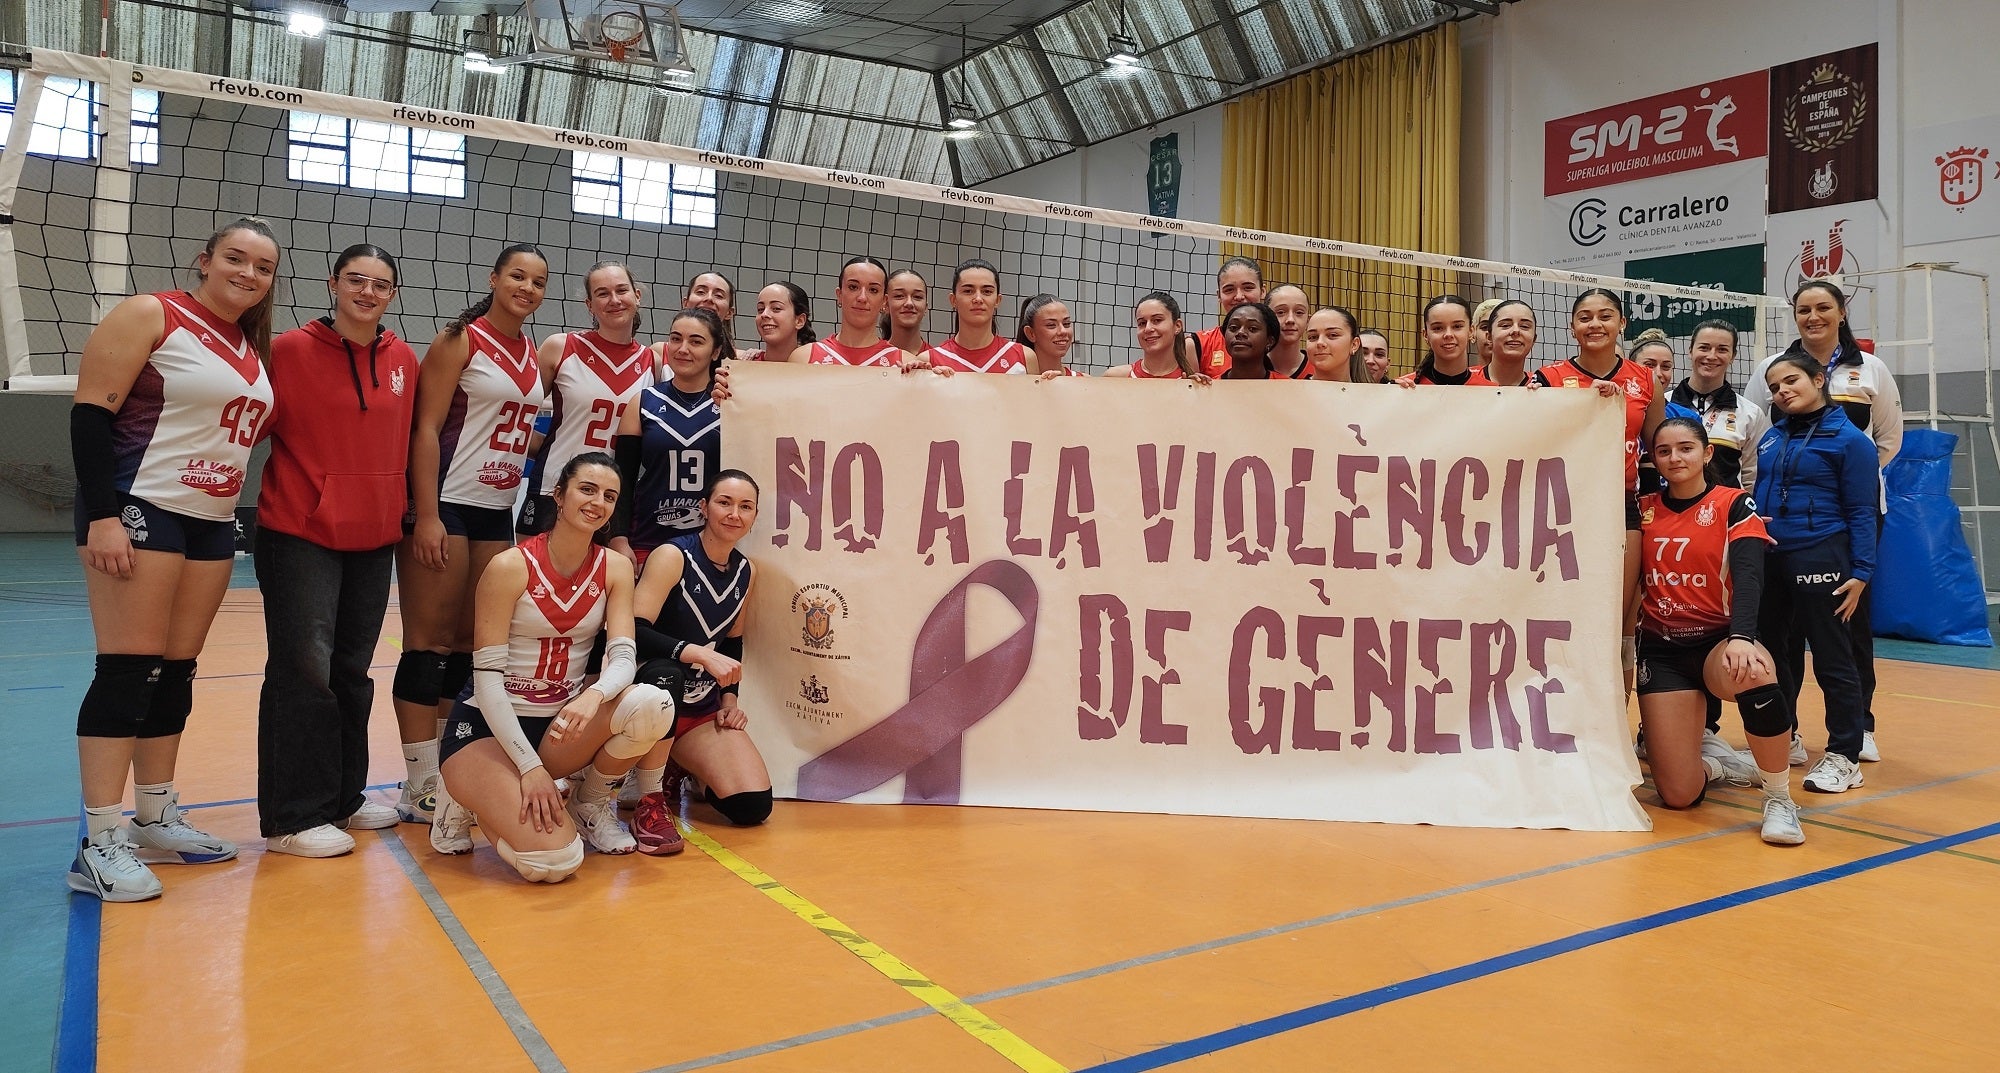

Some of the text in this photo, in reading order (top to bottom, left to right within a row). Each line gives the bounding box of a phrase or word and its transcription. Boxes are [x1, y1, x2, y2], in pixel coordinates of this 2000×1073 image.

[210, 79, 303, 104] rfevb.com
[1801, 87, 1848, 104] CAMPEONES
[1819, 99, 1830, 110] DE
[393, 106, 475, 129] rfevb.com
[1809, 107, 1839, 121] ESPAÑA
[555, 131, 628, 152] rfevb.com
[1568, 105, 1688, 164] SM-2
[698, 151, 764, 170] rfevb.com
[1566, 144, 1704, 182] SUPERLIGA VOLEIBOL MASCULINA
[827, 171, 885, 189] rfevb.com
[1154, 162, 1172, 187] 13
[941, 188, 994, 205] rfevb.com
[1045, 204, 1093, 219] rfevb.com
[1619, 196, 1728, 226] Carralero
[1139, 216, 1183, 231] rfevb.com
[1619, 219, 1722, 240] CLÍNICA DENTAL AVANZAD
[1226, 228, 1267, 242] rfevb.com
[1305, 239, 1343, 251] rfevb.com
[1379, 249, 1414, 261] rfevb.com
[1447, 258, 1480, 269] rfevb.com
[1511, 266, 1541, 277] rfevb.com
[1570, 273, 1598, 284] rfevb.com
[1624, 280, 1651, 291] rfevb.com
[1675, 286, 1701, 296] rfevb.com
[220, 395, 267, 448] 43
[489, 400, 540, 454] 25
[187, 459, 205, 468] LA
[483, 461, 495, 469] LA
[668, 449, 705, 491] 13
[180, 474, 218, 484] GRUAS
[479, 473, 503, 481] GRUAS
[658, 498, 702, 509] LA VARIA
[771, 423, 1580, 582] NO A LA VIOLÈNCIA
[657, 511, 681, 522] GRUAS
[1654, 538, 1690, 561] 77
[1646, 568, 1707, 587] ahora
[1796, 572, 1841, 584] FVBCV
[830, 588, 849, 619] MUNICIPAL
[534, 636, 574, 680] 18
[1077, 578, 1578, 755] DE GÈNERE
[504, 681, 537, 690] GRUAS
[785, 701, 844, 719] EXCM. AJUNTAMENT
